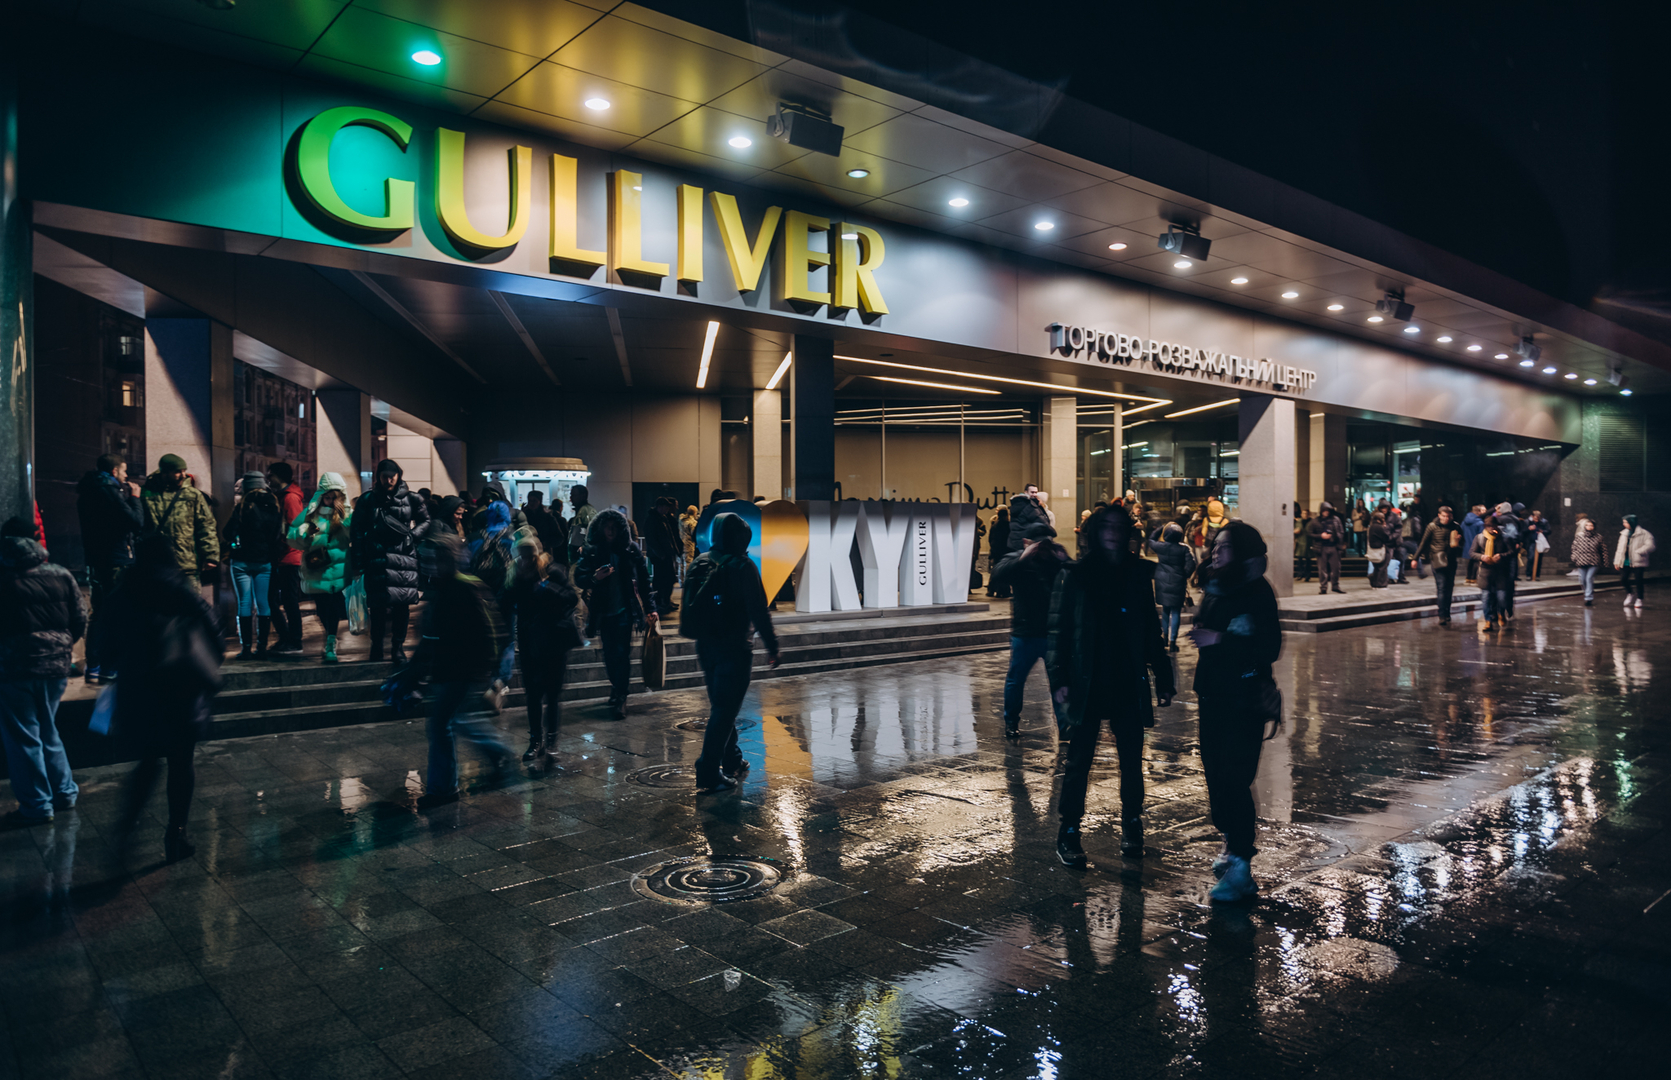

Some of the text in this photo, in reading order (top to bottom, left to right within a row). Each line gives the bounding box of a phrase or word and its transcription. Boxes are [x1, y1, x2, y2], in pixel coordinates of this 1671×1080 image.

[297, 106, 889, 316] GULLIVER
[1277, 364, 1318, 390] ЦЕНТР
[944, 481, 1016, 510] Dutt
[798, 500, 977, 613] KYIV
[918, 521, 928, 586] GULLIVER
